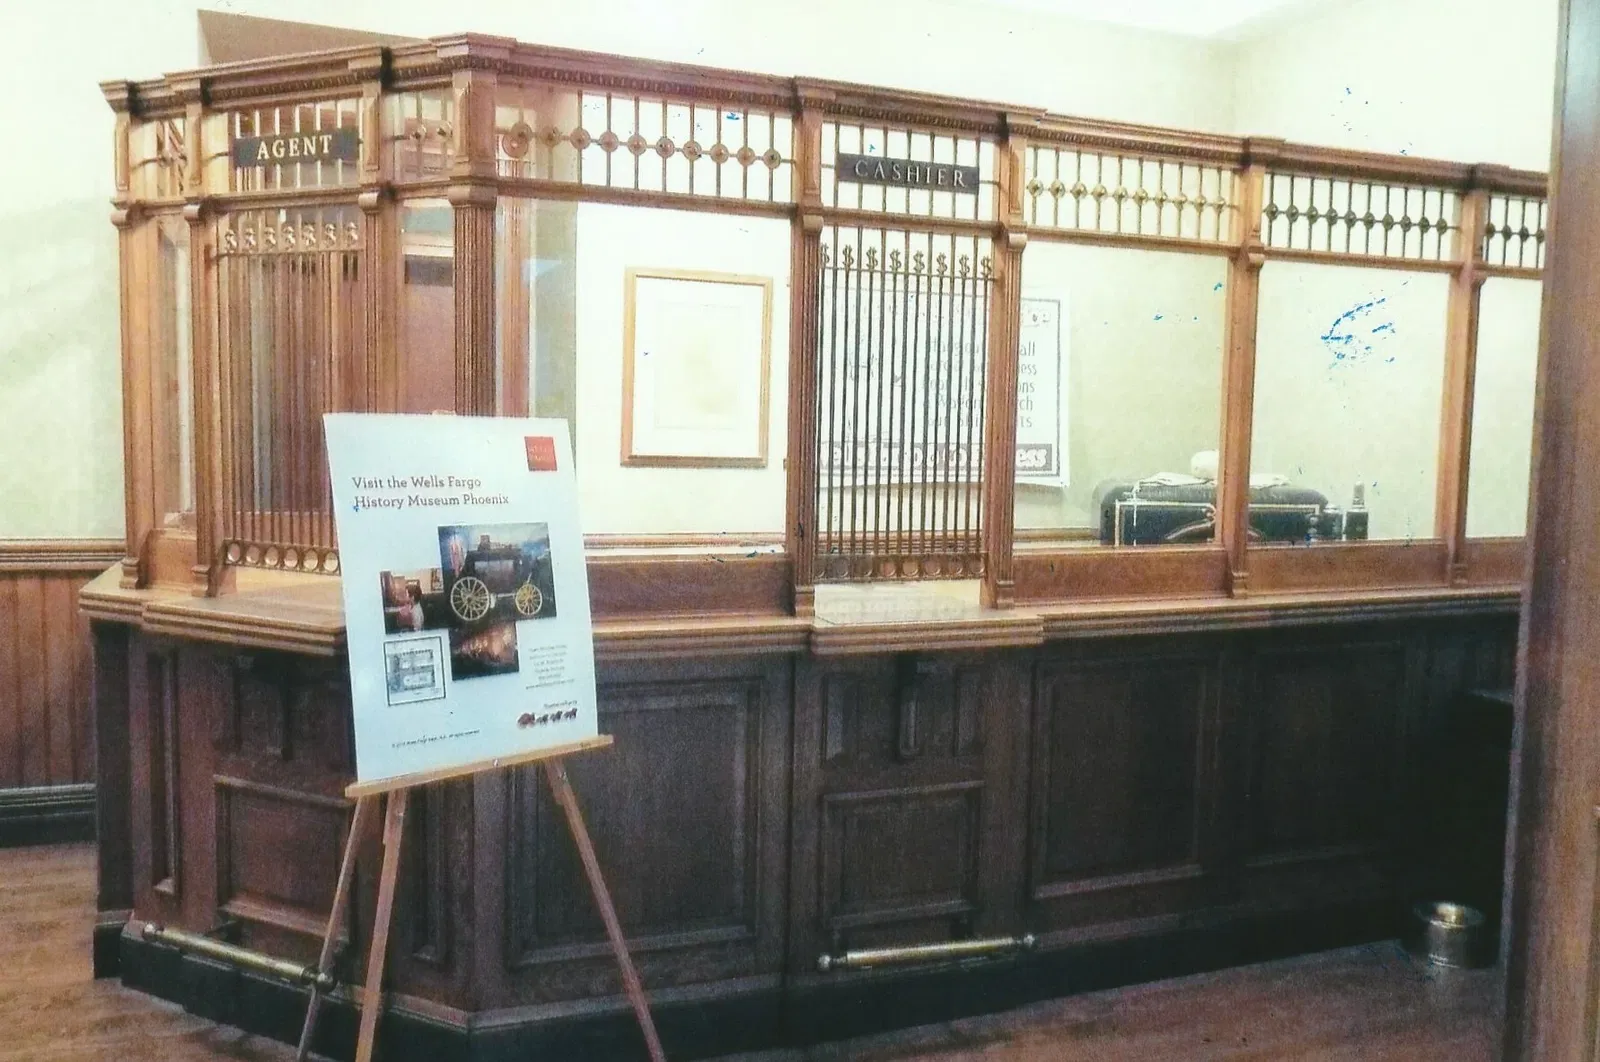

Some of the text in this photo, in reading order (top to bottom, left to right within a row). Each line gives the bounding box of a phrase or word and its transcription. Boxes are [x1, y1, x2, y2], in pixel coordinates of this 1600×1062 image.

[256, 134, 332, 160] AGENT
[854, 159, 966, 187] CASHIER
[351, 475, 482, 490] Visit the Wells Fargo
[354, 490, 509, 510] History Museum Phoenix
